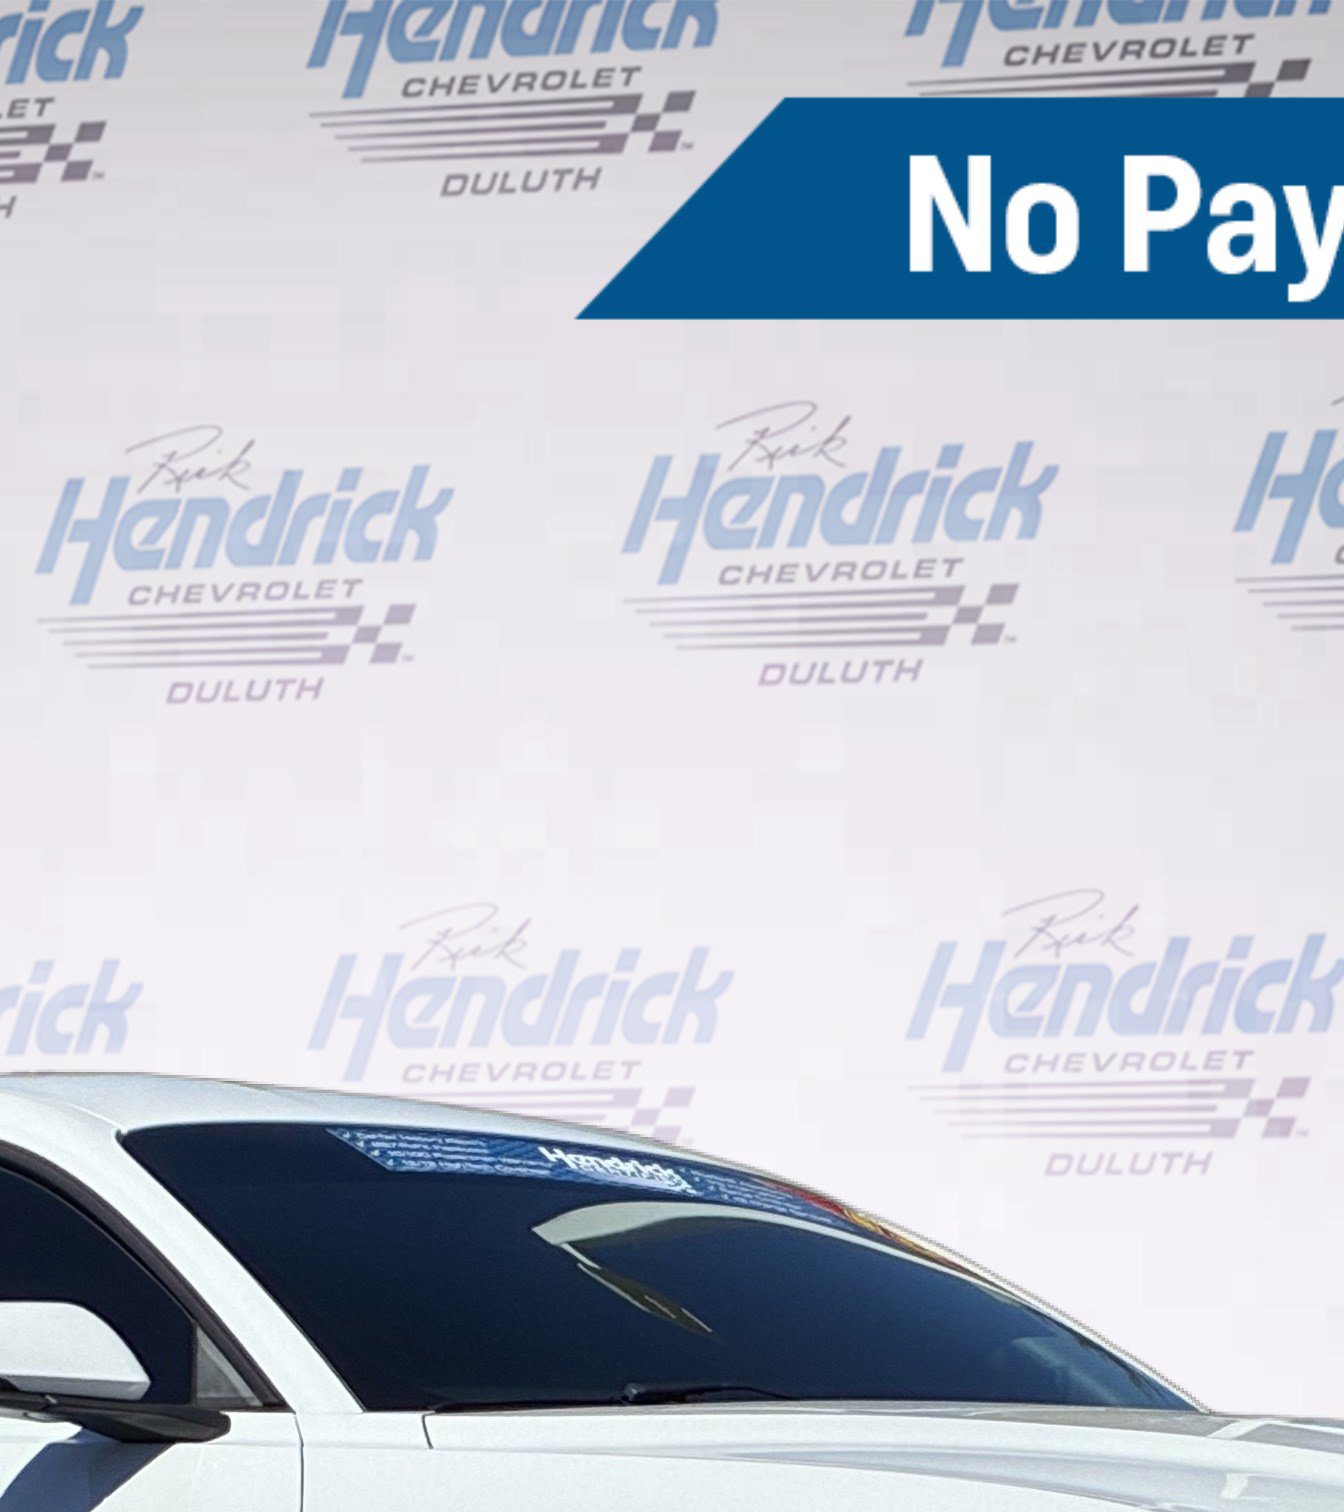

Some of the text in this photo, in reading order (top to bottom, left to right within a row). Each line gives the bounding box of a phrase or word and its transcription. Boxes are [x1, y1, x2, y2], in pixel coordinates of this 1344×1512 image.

[1005, 35, 1253, 65] CHEVROLET
[401, 66, 642, 99] CHEVROLET
[440, 166, 602, 198] DULUTH
[619, 440, 1060, 587] Hendrick
[33, 464, 455, 607] Hendrick
[718, 557, 964, 586] CHEVROLET
[127, 578, 364, 606] CHEVROLET
[757, 658, 924, 687] DULUTH
[165, 677, 325, 705] DULUTH
[306, 946, 735, 1083] Hendrick
[401, 1059, 642, 1083] CHEVROLET
[1004, 1049, 1255, 1074] CHEVROLET
[1045, 1152, 1213, 1176] DULUTH
